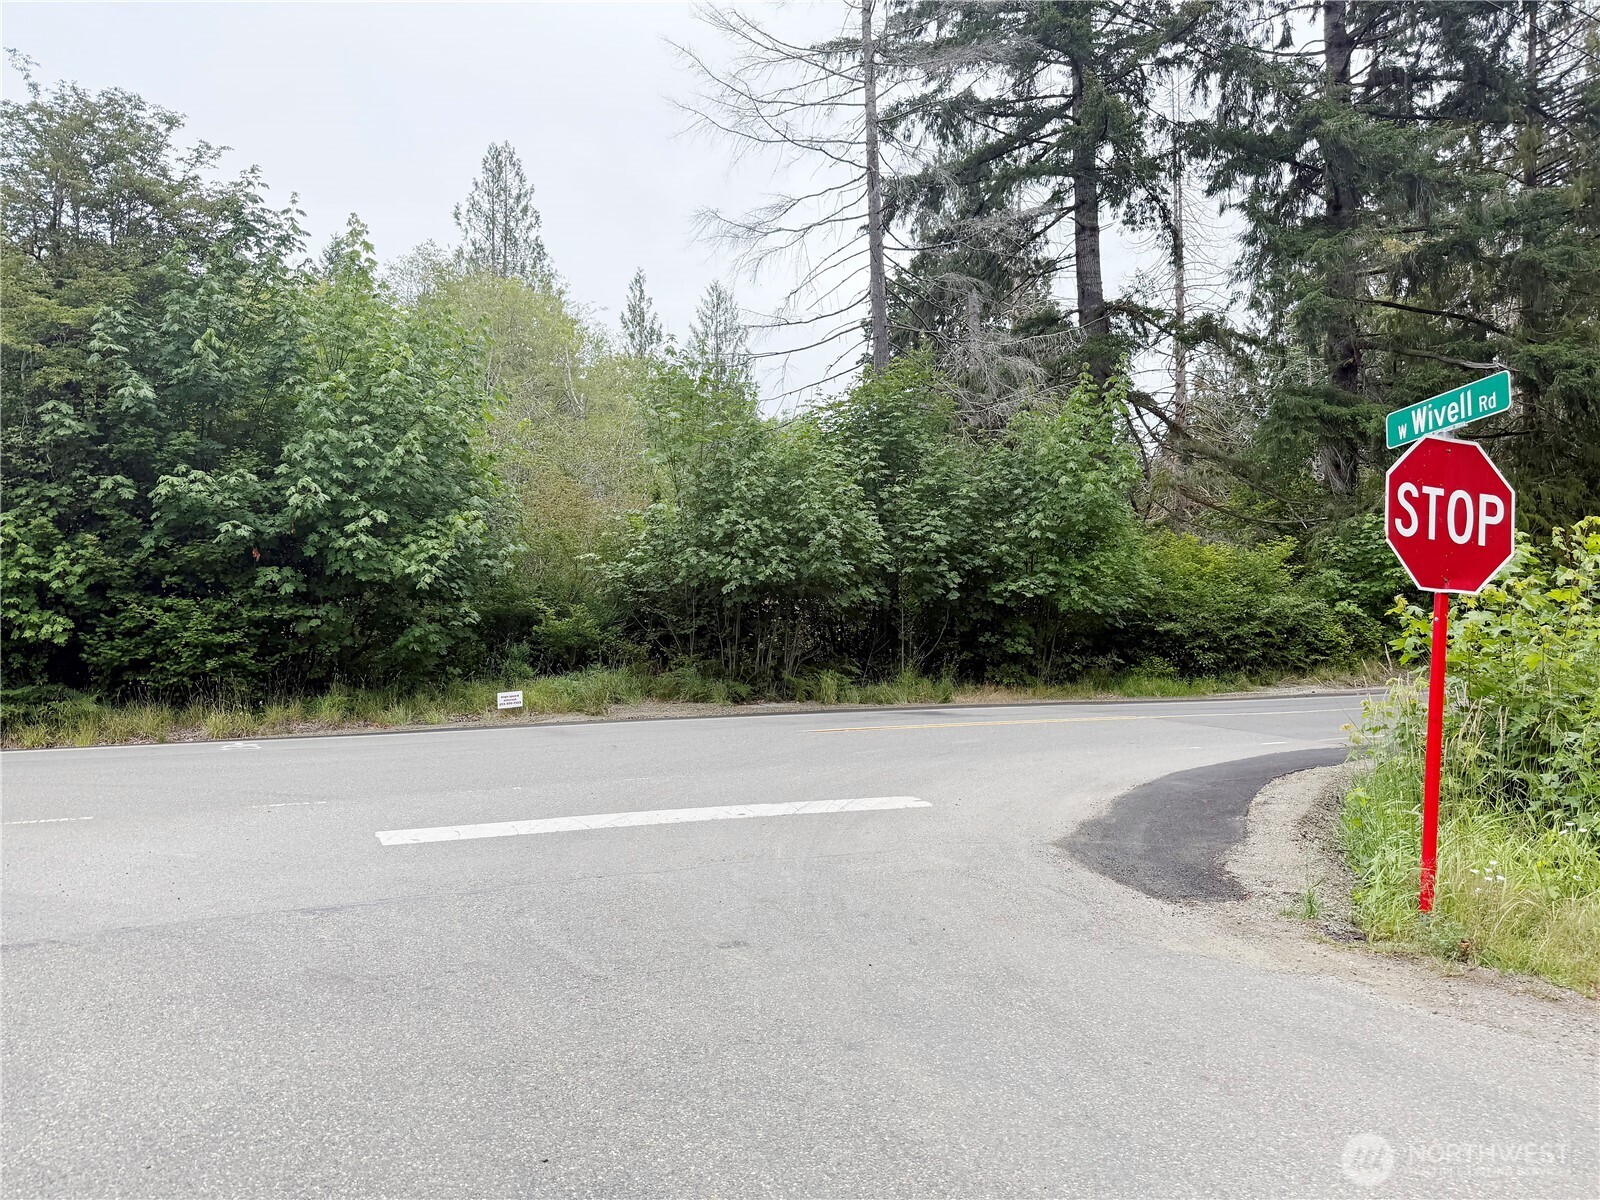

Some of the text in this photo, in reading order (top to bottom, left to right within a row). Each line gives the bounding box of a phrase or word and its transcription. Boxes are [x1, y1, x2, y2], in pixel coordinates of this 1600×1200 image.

[1398, 389, 1497, 440] W Wivell Rd
[1394, 481, 1505, 547] STOP
